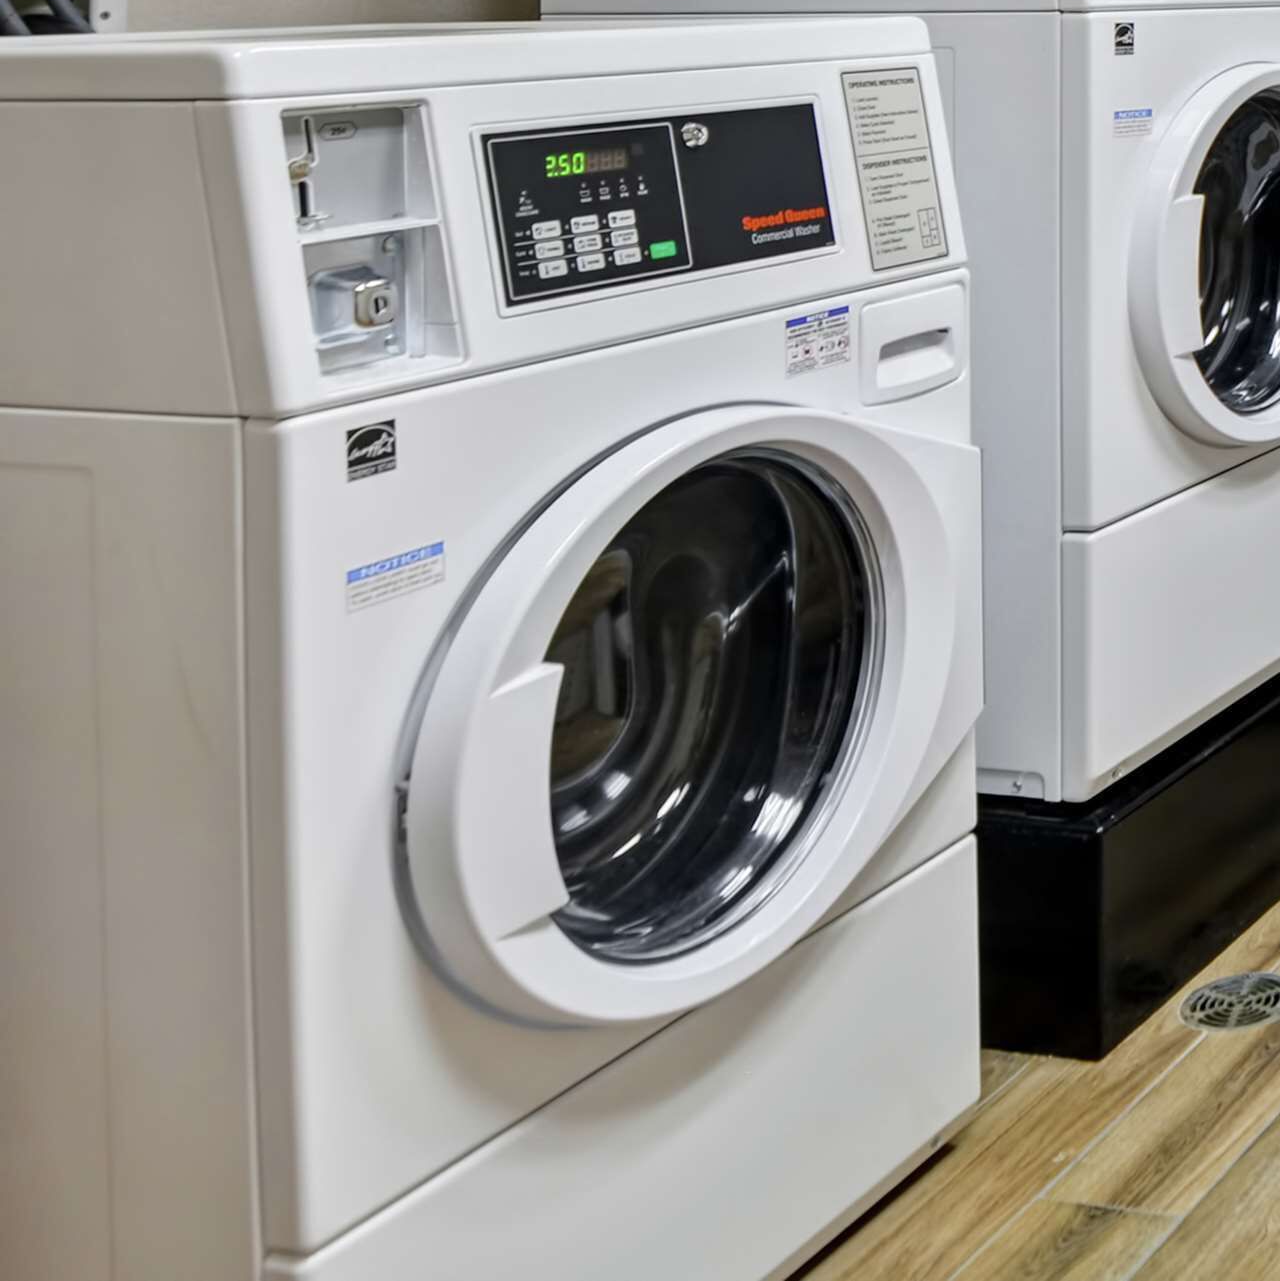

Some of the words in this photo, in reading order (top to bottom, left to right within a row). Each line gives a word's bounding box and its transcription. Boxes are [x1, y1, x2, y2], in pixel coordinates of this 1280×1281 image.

[742, 210, 784, 232] Speed
[785, 206, 826, 223] Queen
[751, 227, 795, 245] Commercial
[359, 546, 432, 579] NOTICE
